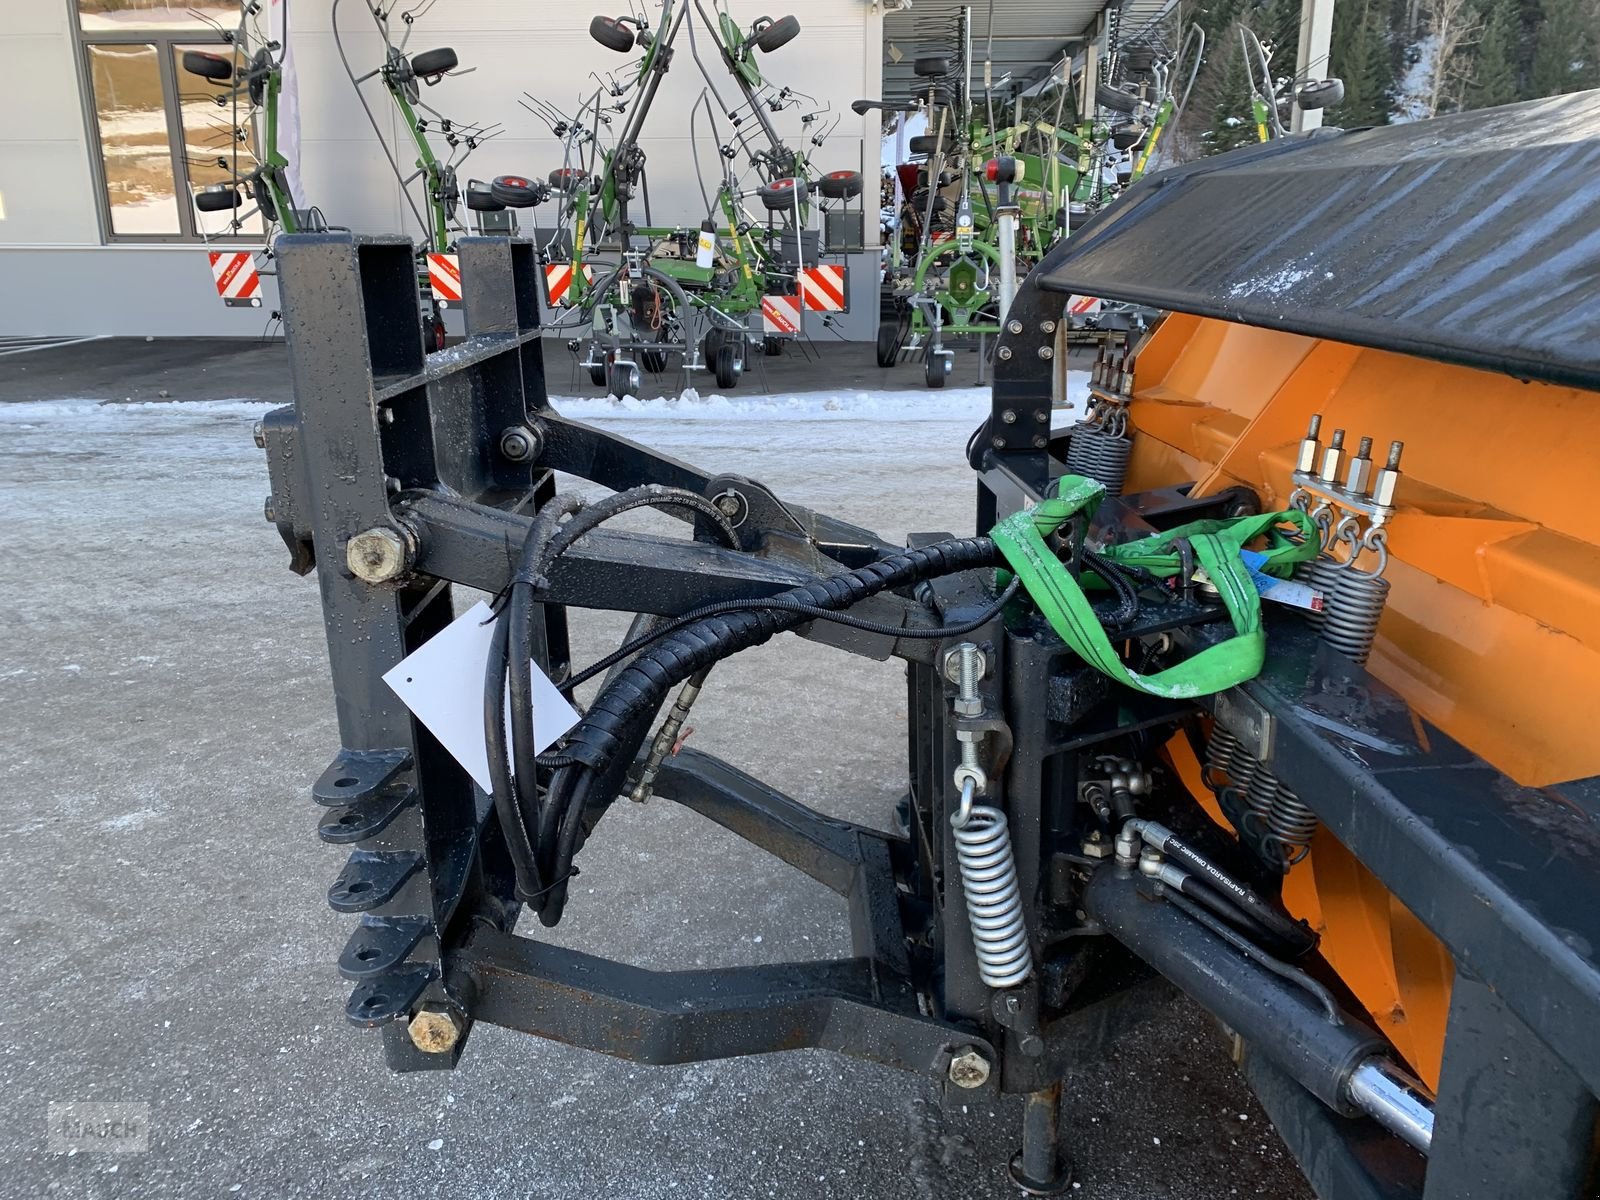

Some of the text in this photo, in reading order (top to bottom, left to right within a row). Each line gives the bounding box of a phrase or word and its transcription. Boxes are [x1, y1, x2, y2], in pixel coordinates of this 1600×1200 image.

[1169, 838, 1246, 896] RAPISARDA DINAMIC 2SC
